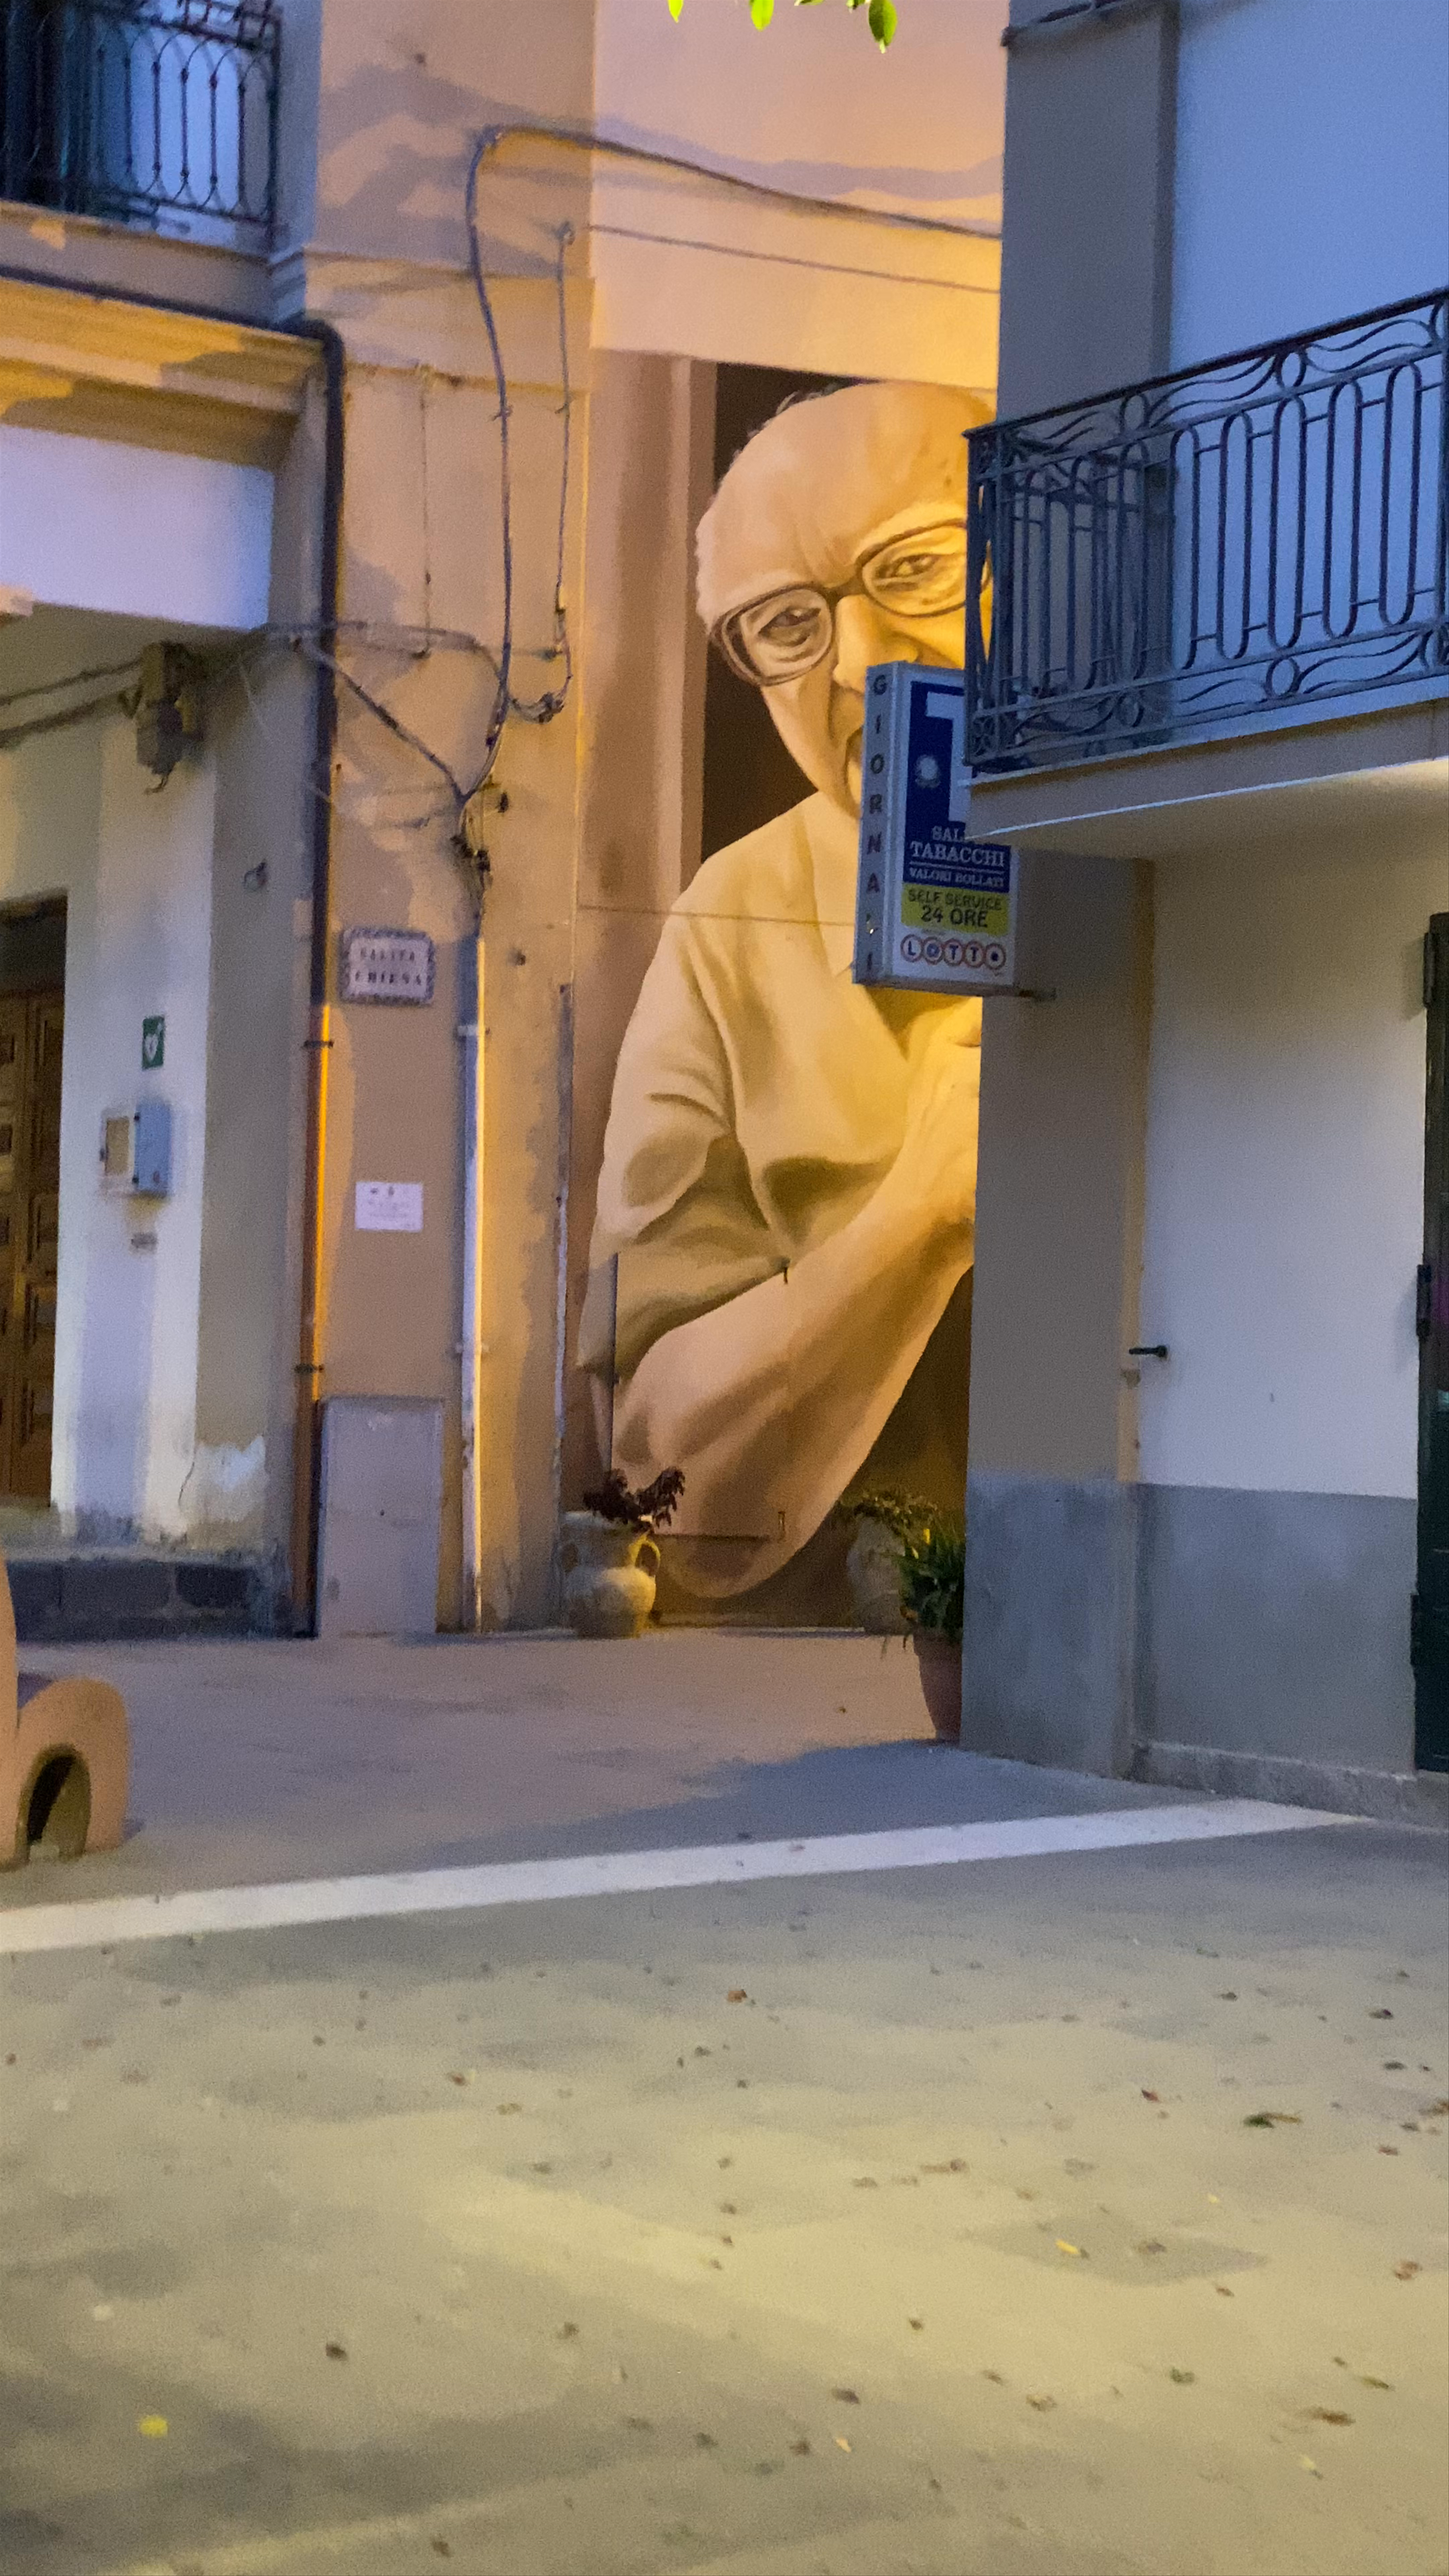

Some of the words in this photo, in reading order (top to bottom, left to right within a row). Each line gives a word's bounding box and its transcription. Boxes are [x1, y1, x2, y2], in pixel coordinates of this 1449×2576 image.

[866, 675, 888, 971] GIORNAI
[931, 825, 966, 843] SAL
[910, 841, 1005, 867] TABACCHI
[909, 867, 952, 882] VALORI
[955, 873, 1004, 887] BOLLATI
[908, 888, 943, 904] SELF
[945, 892, 1002, 911] SERVICE
[921, 904, 943, 923] 24
[950, 907, 988, 928] ORE
[902, 936, 1004, 967] LOTTO
